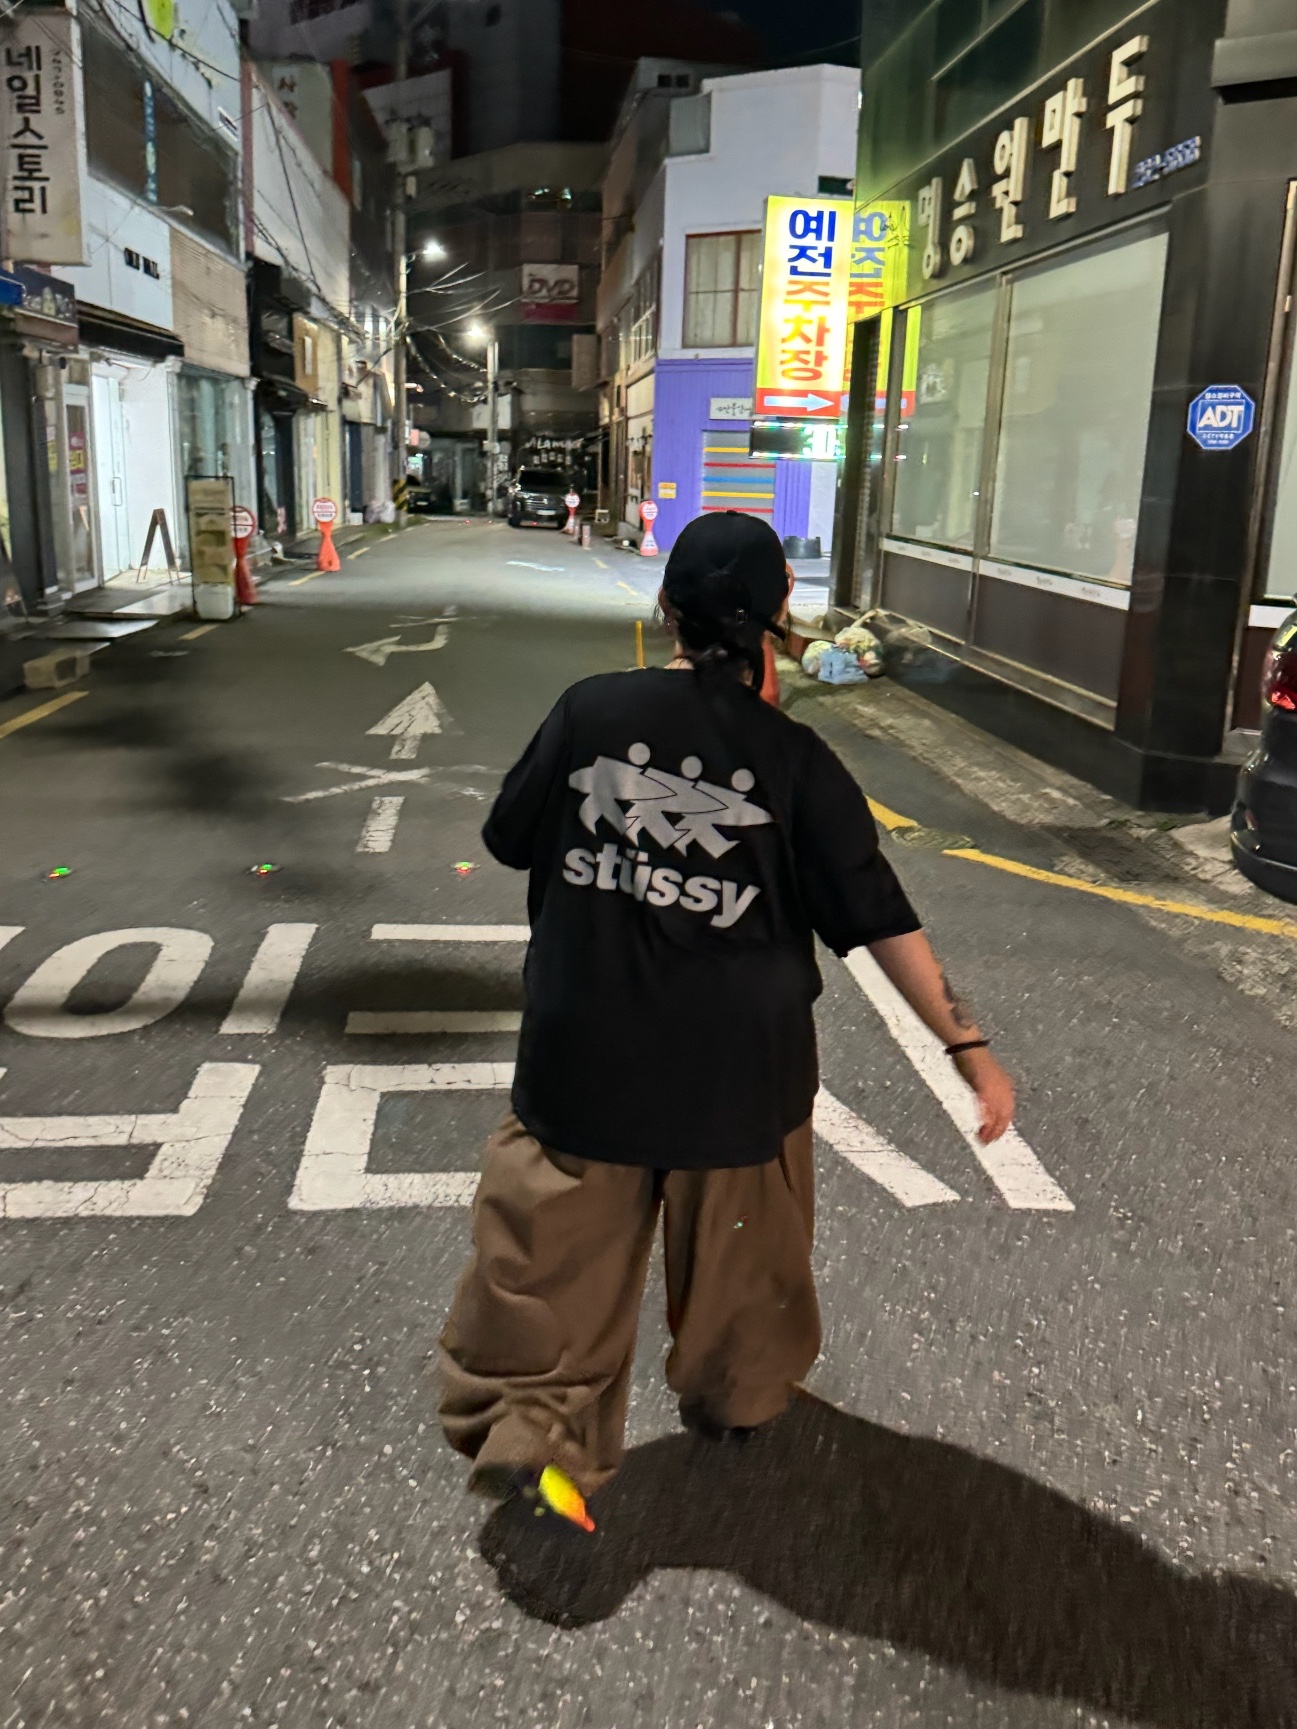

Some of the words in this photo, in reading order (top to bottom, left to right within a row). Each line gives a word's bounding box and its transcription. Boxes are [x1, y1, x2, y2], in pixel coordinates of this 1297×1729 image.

[5, 45, 50, 214] 네일스토리
[918, 35, 1149, 280] 명승원만두
[526, 278, 577, 297] DVD
[1198, 405, 1244, 428] ADT
